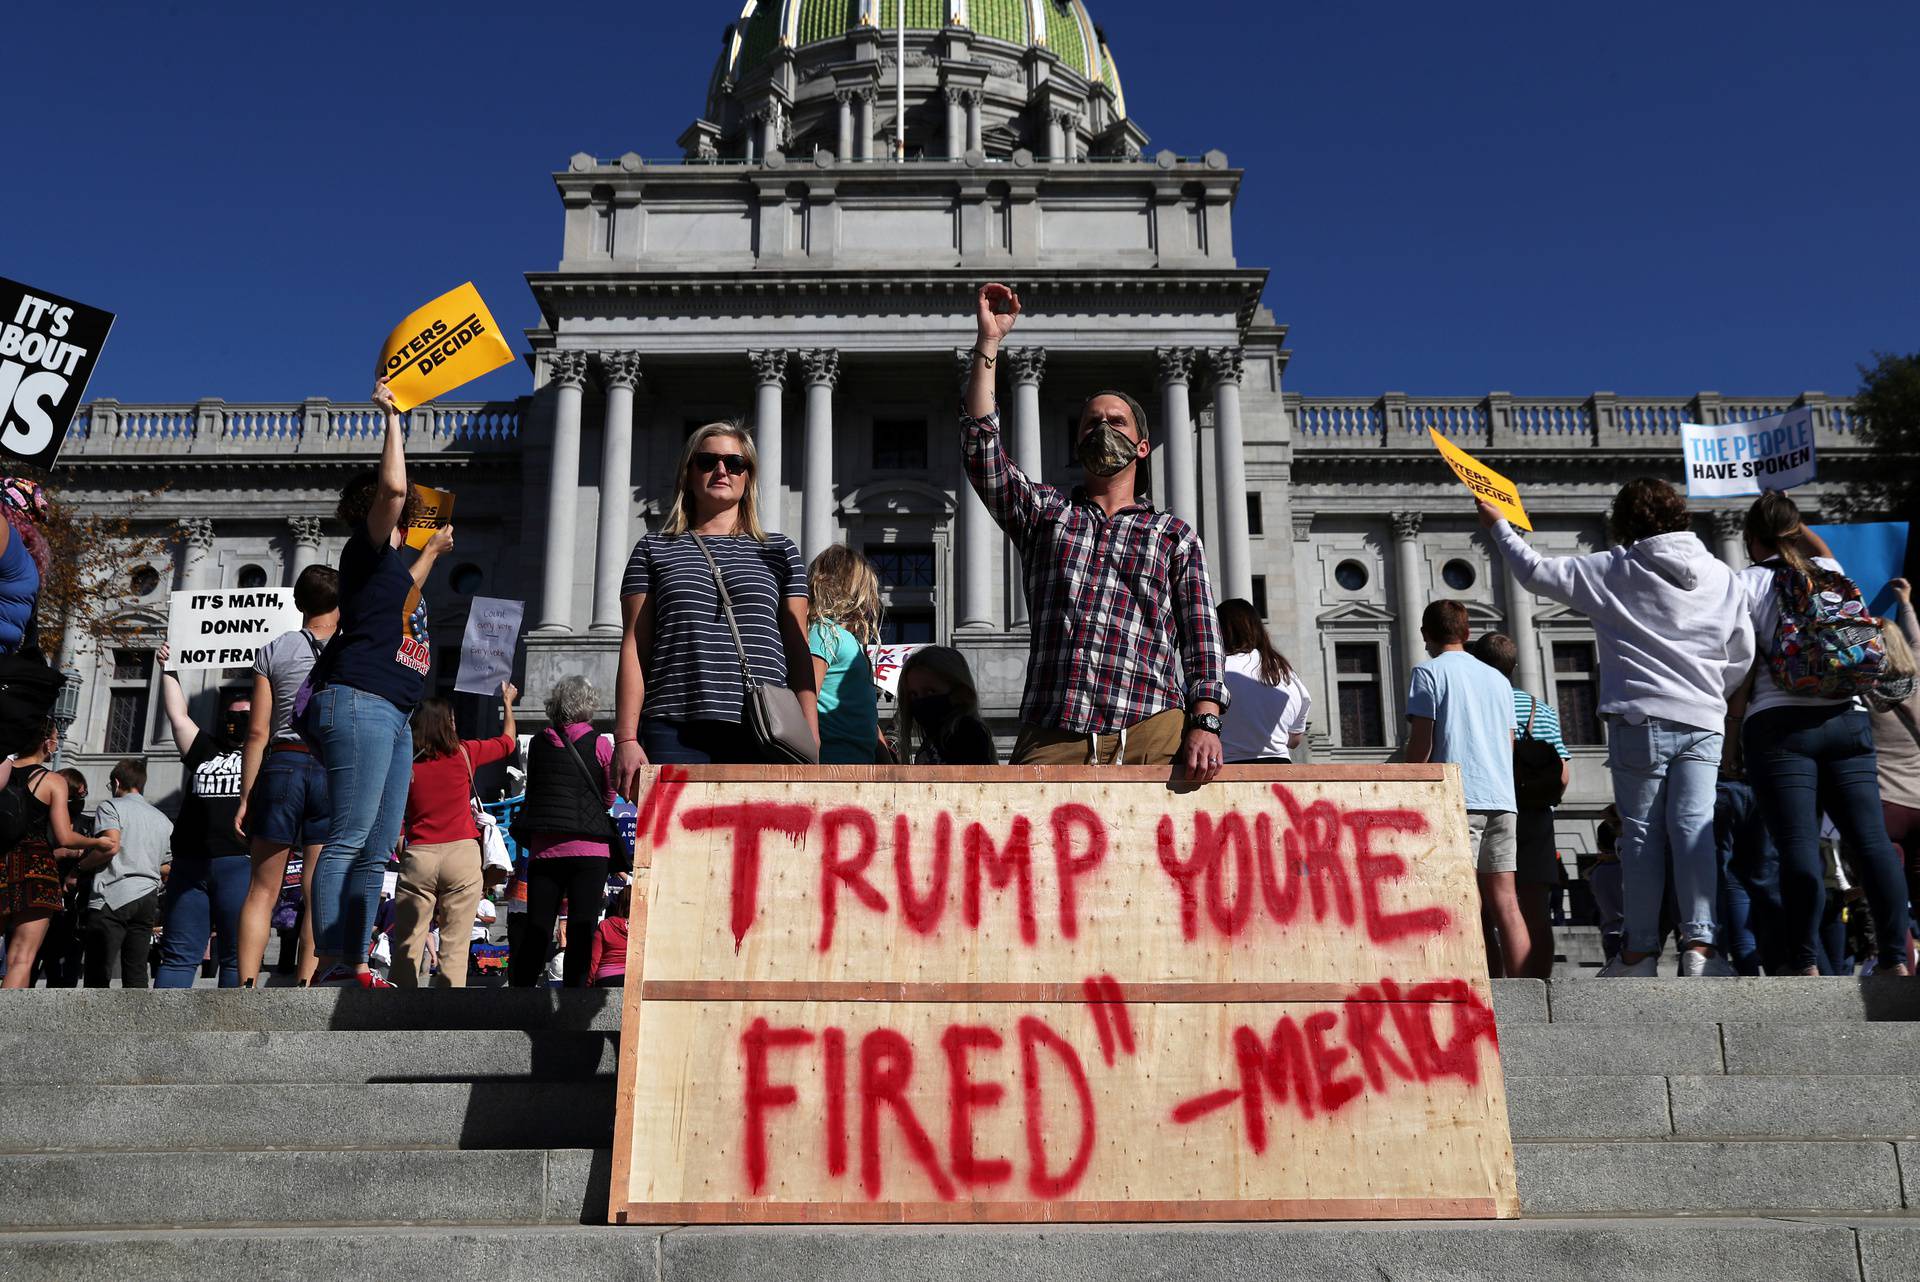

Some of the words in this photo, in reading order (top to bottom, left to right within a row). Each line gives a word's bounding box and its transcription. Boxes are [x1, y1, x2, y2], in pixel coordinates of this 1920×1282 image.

[14, 294, 74, 337] IT'S
[0, 322, 87, 376] BOUT
[418, 318, 485, 376] DECIDE
[1690, 438, 1729, 462] THE
[1733, 420, 1808, 460] PEOPLE
[1693, 462, 1738, 479] HAVE
[1742, 446, 1810, 477] SPOKEN
[1467, 480, 1516, 506] DECIDE
[191, 595, 223, 609] IT'S
[229, 593, 283, 609] MATH,
[201, 619, 269, 634] DONNY.
[180, 649, 216, 663] NOT
